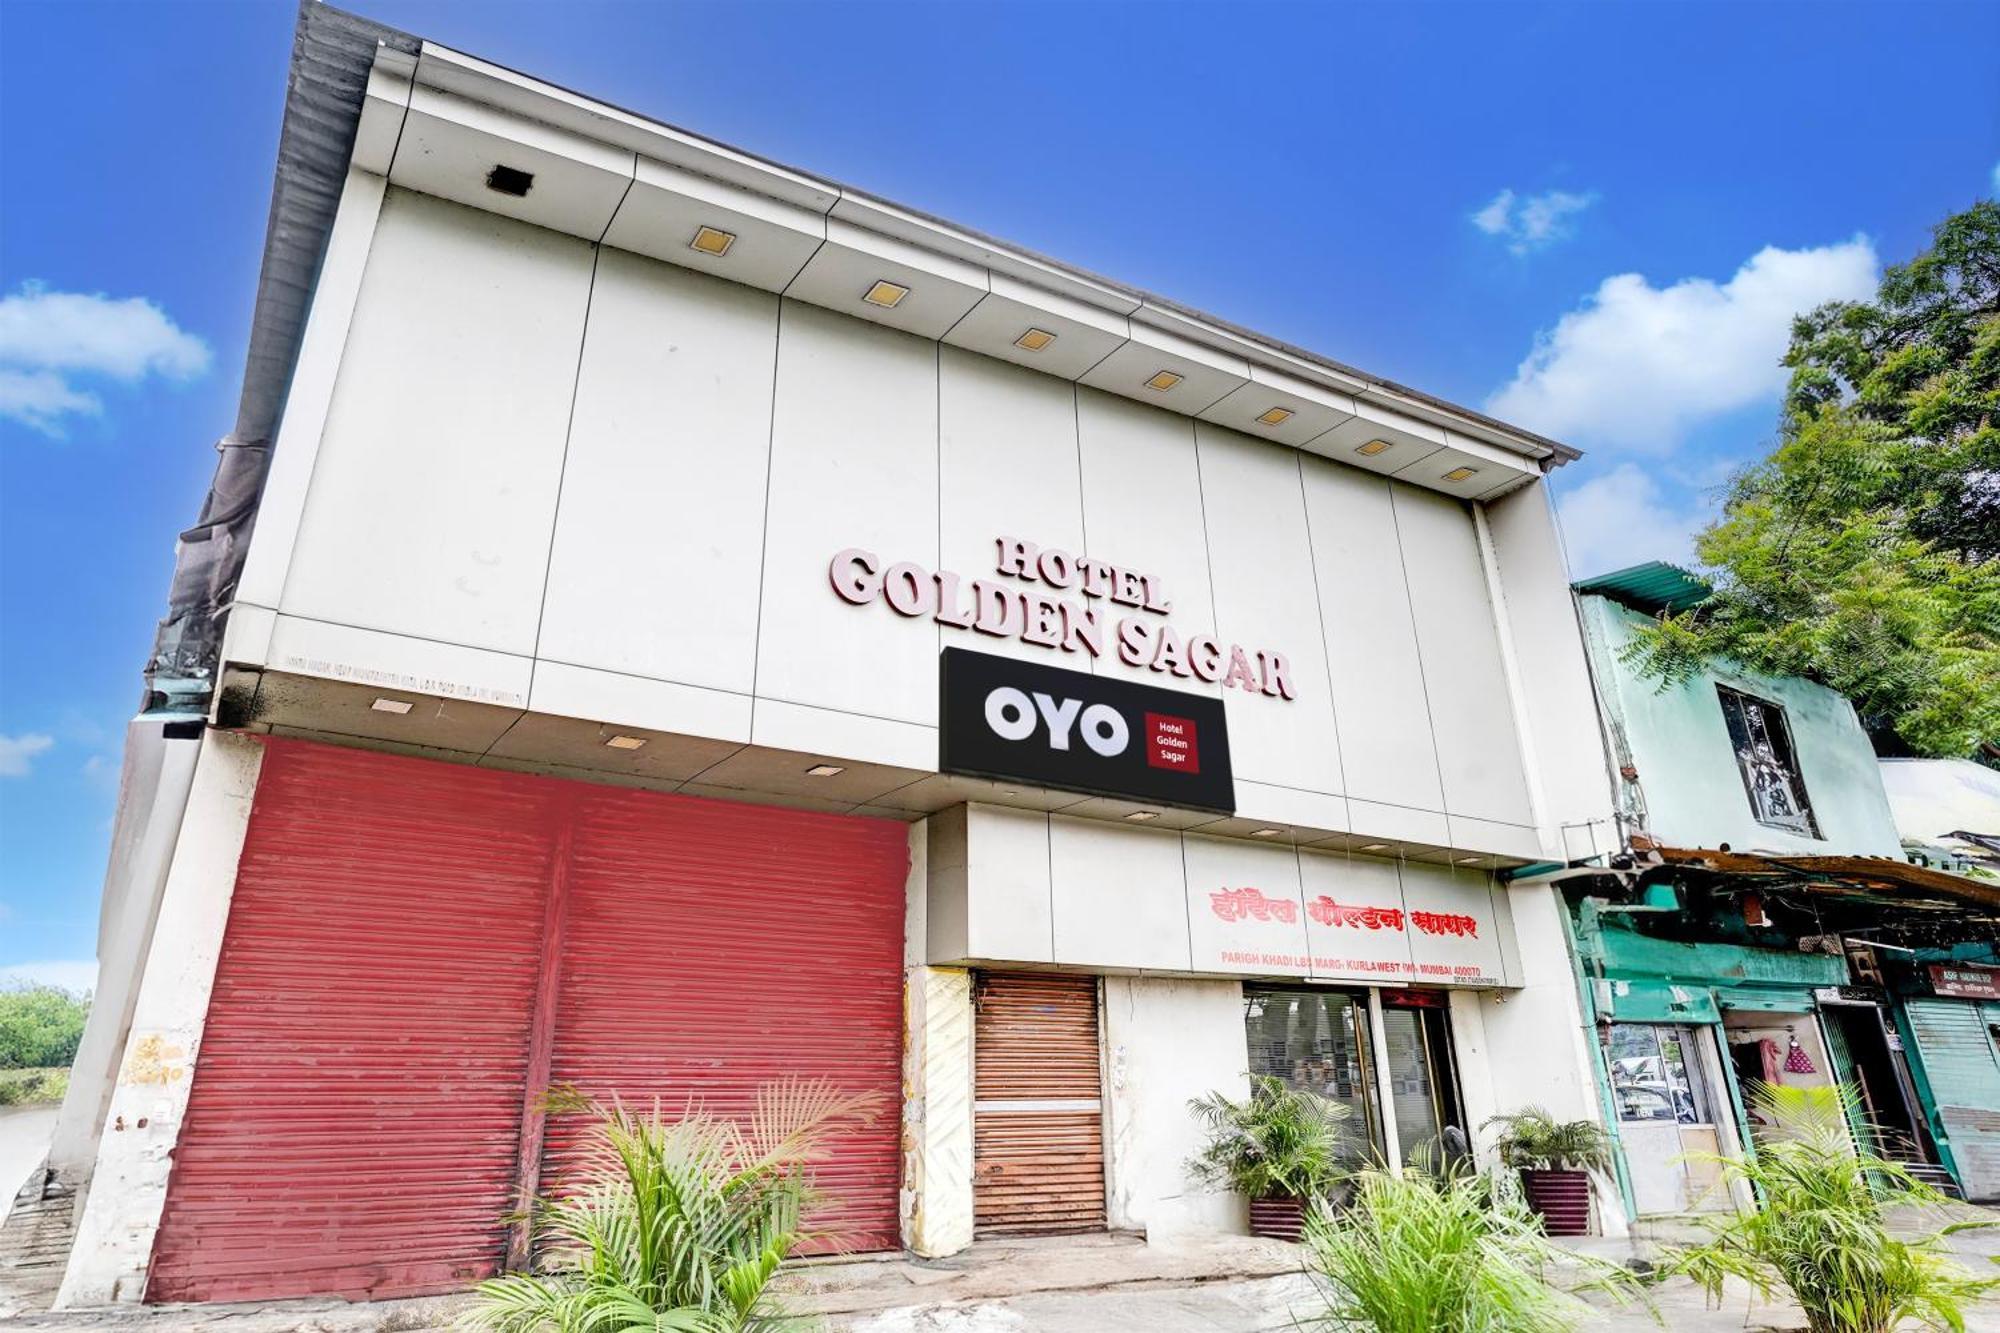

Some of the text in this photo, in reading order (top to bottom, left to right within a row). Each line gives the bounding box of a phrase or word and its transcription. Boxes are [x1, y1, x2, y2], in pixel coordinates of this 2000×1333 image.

[996, 536, 1171, 614] HOTEL
[829, 548, 1297, 701] GOLDEN SAGAR
[985, 686, 1129, 757] OYO
[1159, 722, 1183, 735] Hotel
[1156, 735, 1188, 749] Golden
[1160, 750, 1186, 763] Sagar
[1262, 953, 1293, 967] KHADI
[1346, 960, 1376, 972] KURLA
[1376, 961, 1400, 973] WEST
